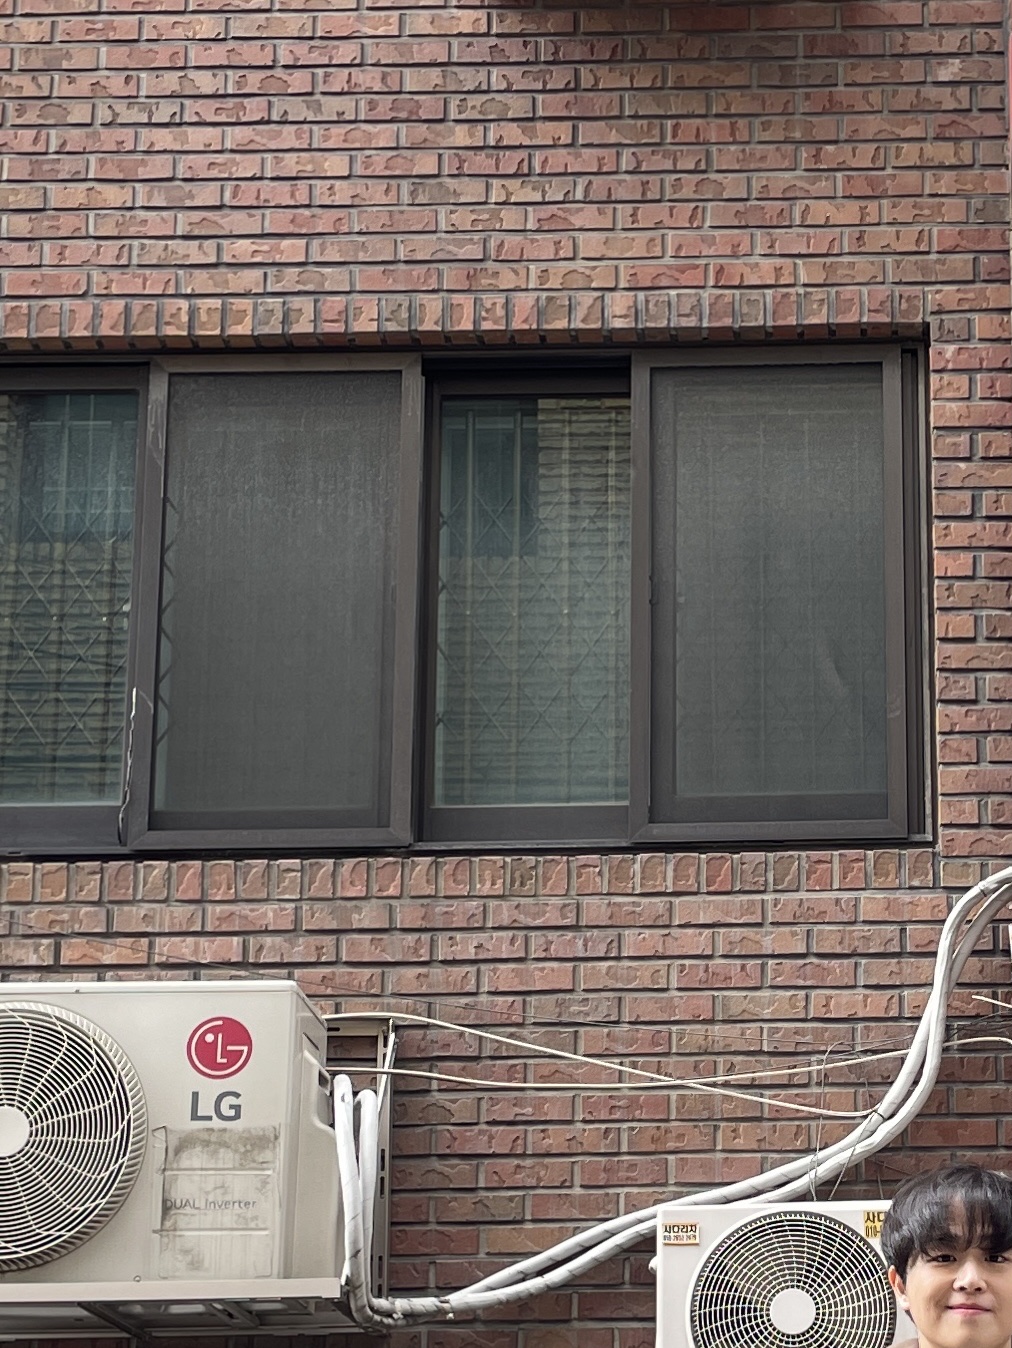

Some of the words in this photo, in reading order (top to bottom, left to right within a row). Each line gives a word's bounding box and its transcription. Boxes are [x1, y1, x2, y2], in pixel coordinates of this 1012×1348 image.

[190, 1091, 242, 1122] LG
[165, 1198, 201, 1210] DUAL
[205, 1198, 257, 1210] Inverter
[663, 1224, 697, 1234] 사다리차
